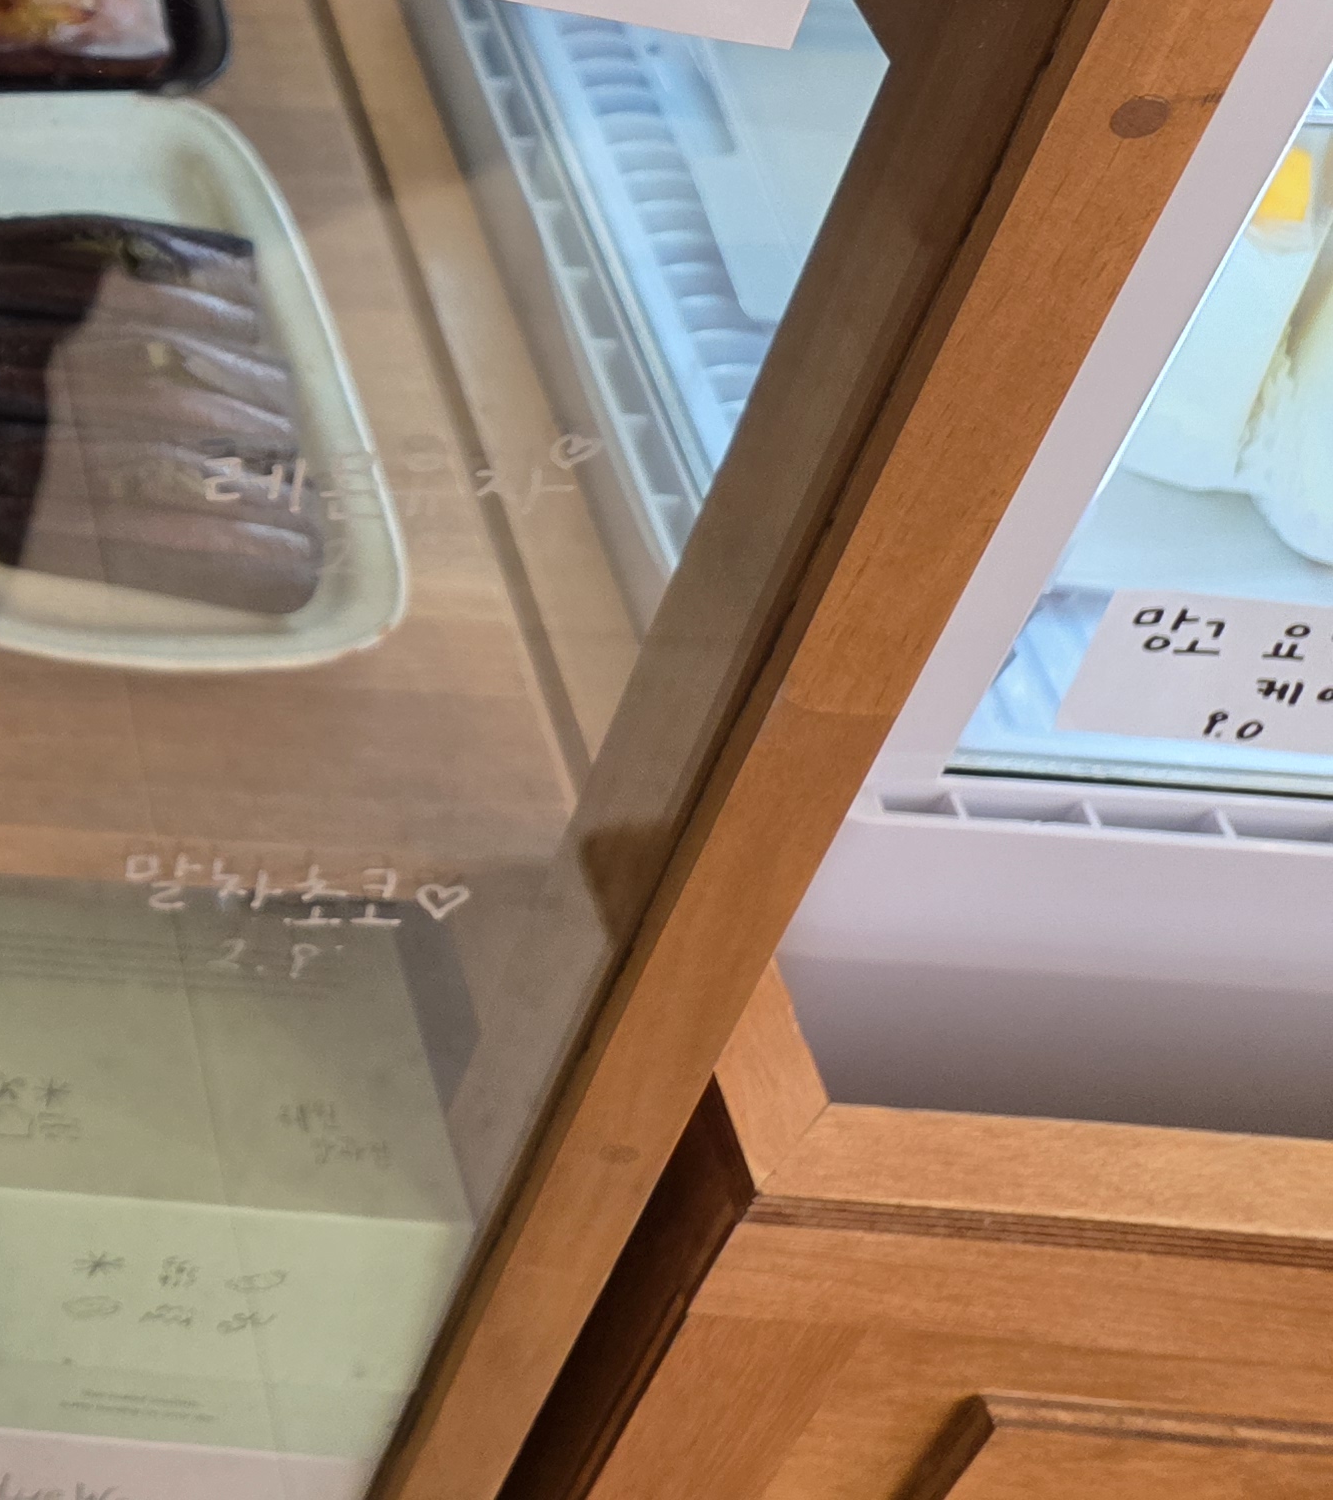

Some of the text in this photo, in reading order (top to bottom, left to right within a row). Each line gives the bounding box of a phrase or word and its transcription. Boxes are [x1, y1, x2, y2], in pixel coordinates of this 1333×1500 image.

[1131, 607, 1333, 662] 망고 요
[1202, 710, 1265, 741] 9.0
